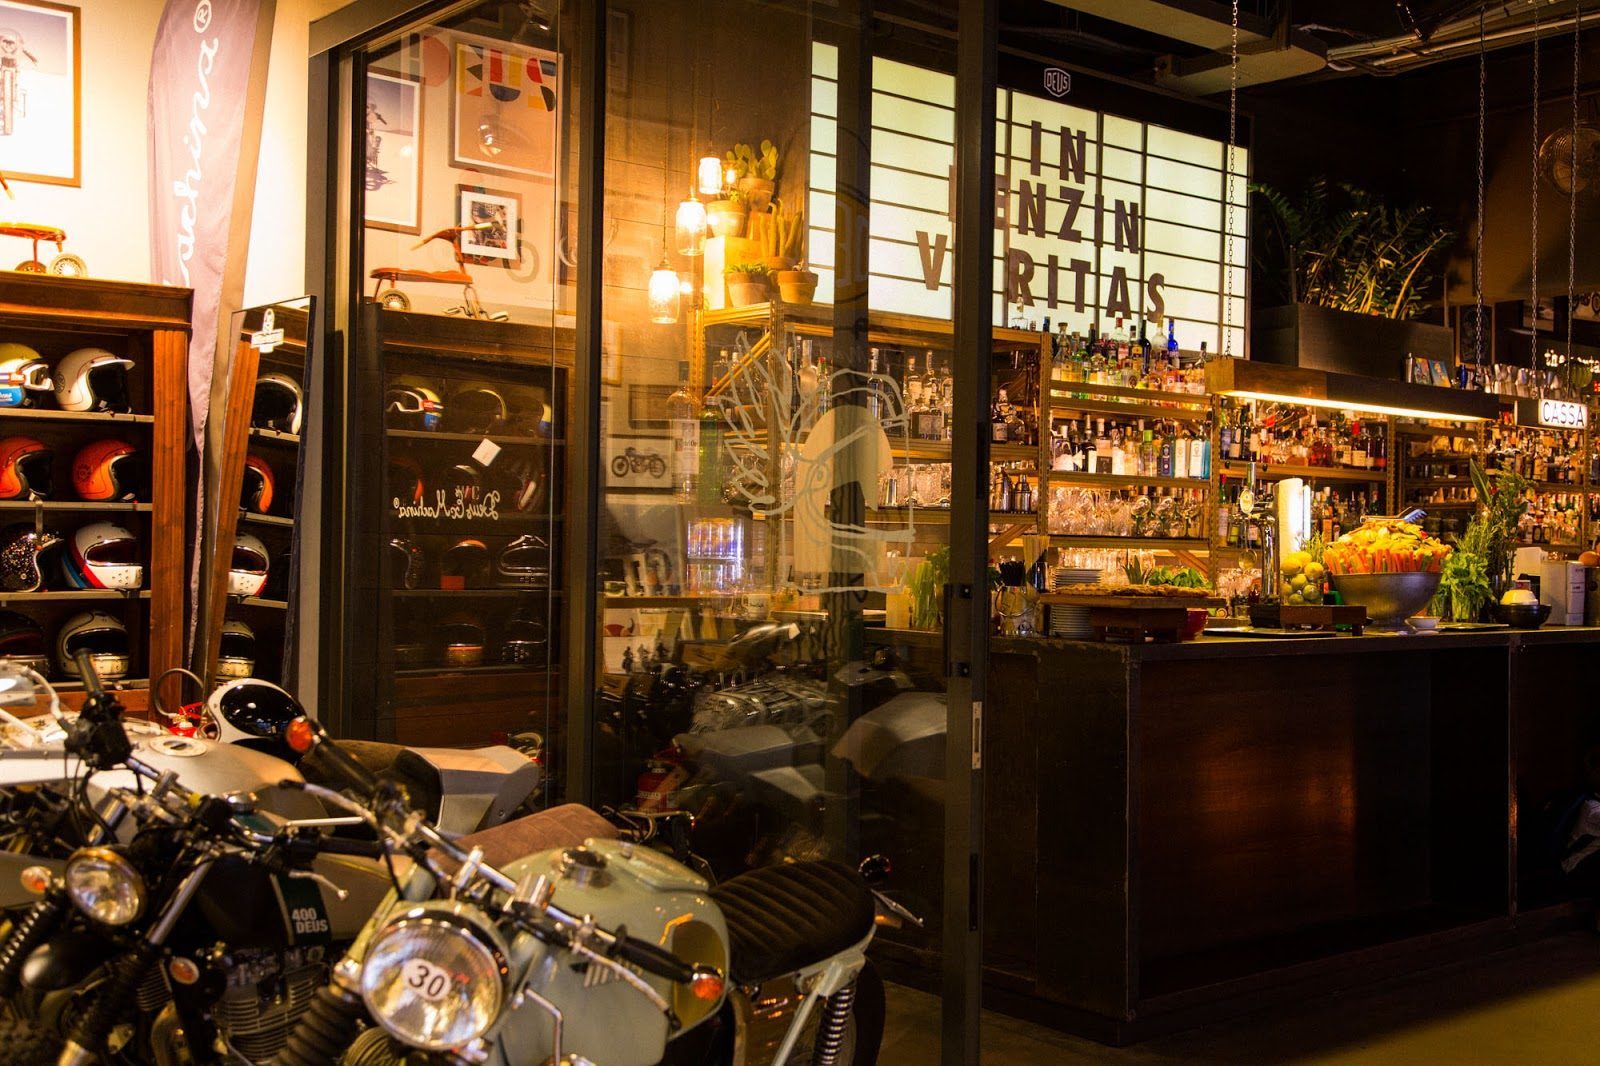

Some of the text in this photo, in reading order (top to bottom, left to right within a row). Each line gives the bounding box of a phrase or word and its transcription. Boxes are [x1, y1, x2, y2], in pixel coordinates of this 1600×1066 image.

[1046, 72, 1068, 93] DEUS
[1030, 120, 1086, 184] IN
[948, 164, 1139, 254] ENZIN
[916, 230, 1165, 323] VRITAS
[1543, 402, 1584, 426] CASSA
[292, 907, 317, 920] 400
[296, 919, 329, 934] DEUS
[409, 965, 445, 997] 30
